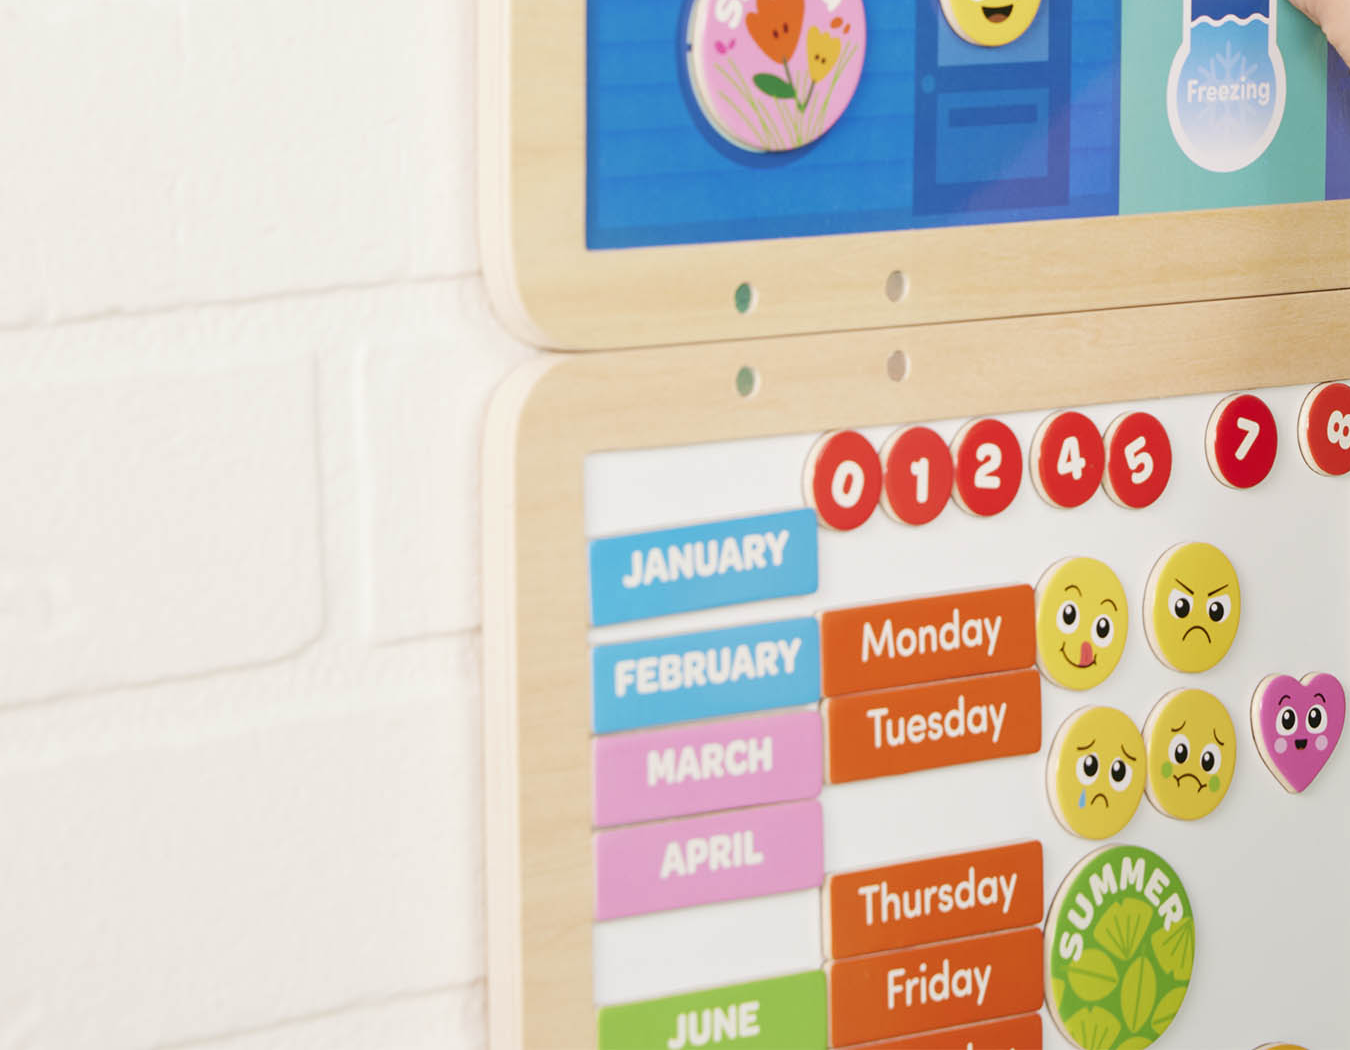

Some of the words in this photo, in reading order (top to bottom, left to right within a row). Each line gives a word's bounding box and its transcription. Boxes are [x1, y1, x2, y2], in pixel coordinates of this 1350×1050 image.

[1187, 76, 1271, 106] Freezing
[1056, 436, 1086, 480] 4
[1125, 437, 1154, 484] 5
[1234, 416, 1260, 461] 7
[832, 461, 864, 508] 0
[910, 457, 930, 503] 1
[975, 443, 1003, 489] 2
[622, 529, 789, 589] JANUARY
[861, 608, 1002, 662] Monday
[614, 637, 801, 698] FEBRUARY
[866, 696, 1007, 748] Tuesday
[646, 737, 773, 787] MARCH
[660, 830, 763, 879] APRIL
[858, 868, 1017, 925] Thursday
[1060, 855, 1183, 961] SUMMER
[886, 958, 992, 1010] Friday
[667, 1000, 760, 1049] JUNE
